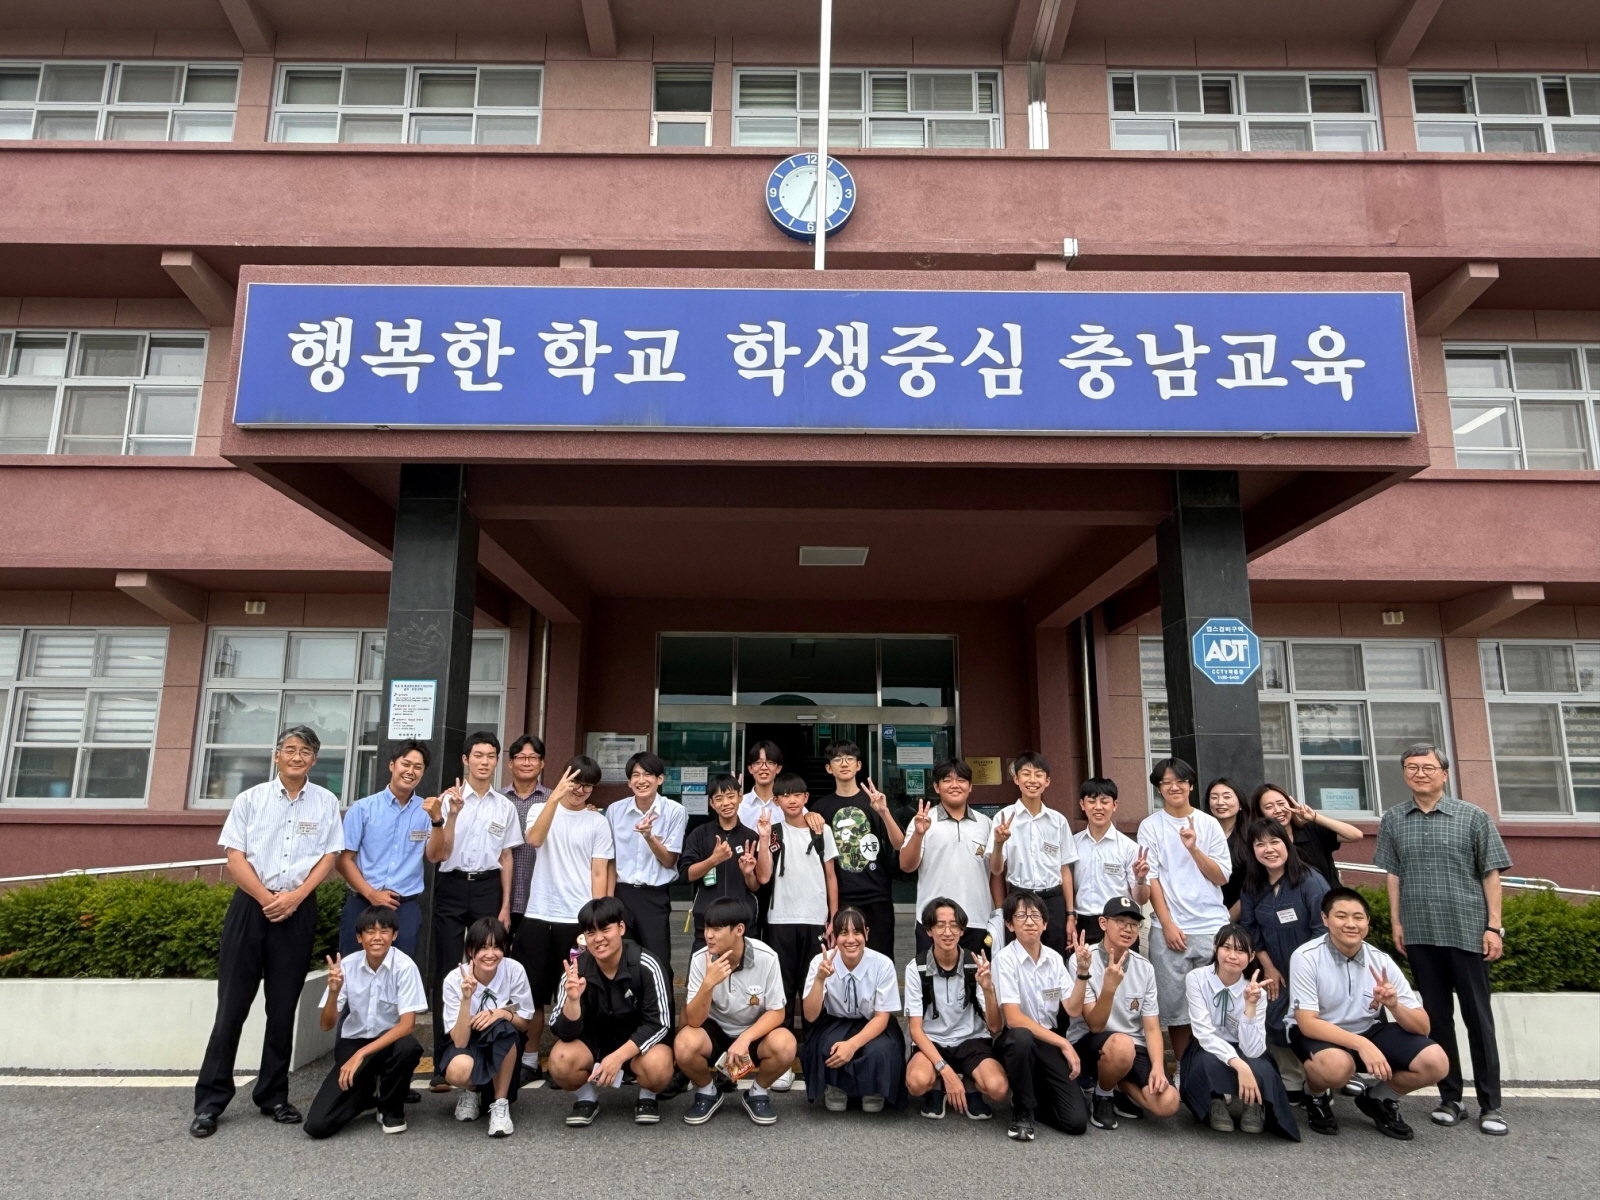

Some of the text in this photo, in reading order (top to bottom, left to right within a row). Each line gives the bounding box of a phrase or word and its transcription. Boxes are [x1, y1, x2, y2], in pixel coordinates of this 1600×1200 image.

[805, 155, 818, 165] 12
[769, 187, 778, 198] 9
[844, 188, 853, 199] 3
[806, 222, 815, 232] 6
[287, 316, 1366, 401] 행복한 학교 학생중심 충남교육
[1205, 639, 1248, 662] ADT
[1120, 897, 1131, 907] C
